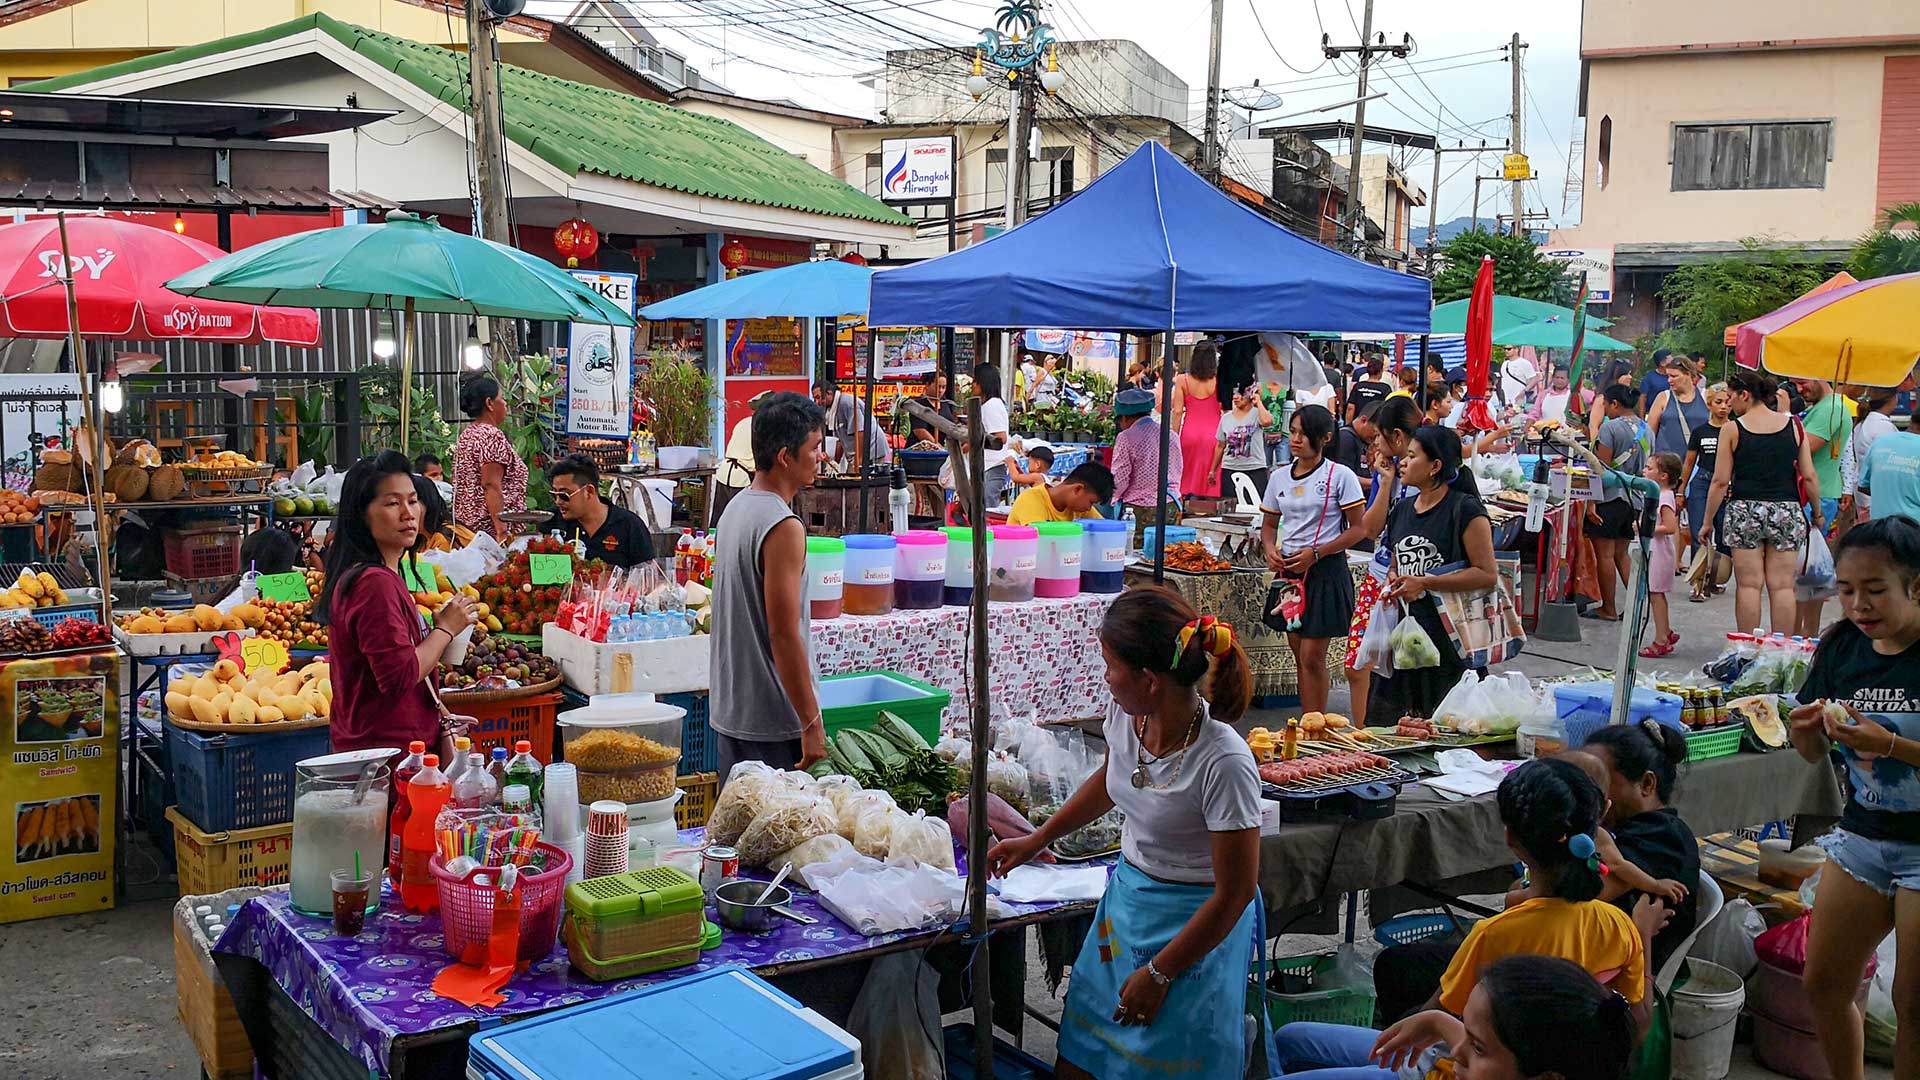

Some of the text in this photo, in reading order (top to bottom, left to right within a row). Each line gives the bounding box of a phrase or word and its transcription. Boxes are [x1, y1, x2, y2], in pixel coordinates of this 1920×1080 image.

[912, 170, 950, 185] Bangkok
[903, 180, 938, 195] Airways
[37, 250, 116, 279] SPY
[572, 398, 589, 410] 250
[578, 415, 617, 424] Automatic
[577, 423, 619, 432] Motor Bike
[272, 575, 295, 587] 50
[245, 643, 278, 668] 50
[1853, 688, 1905, 701] SMILE
